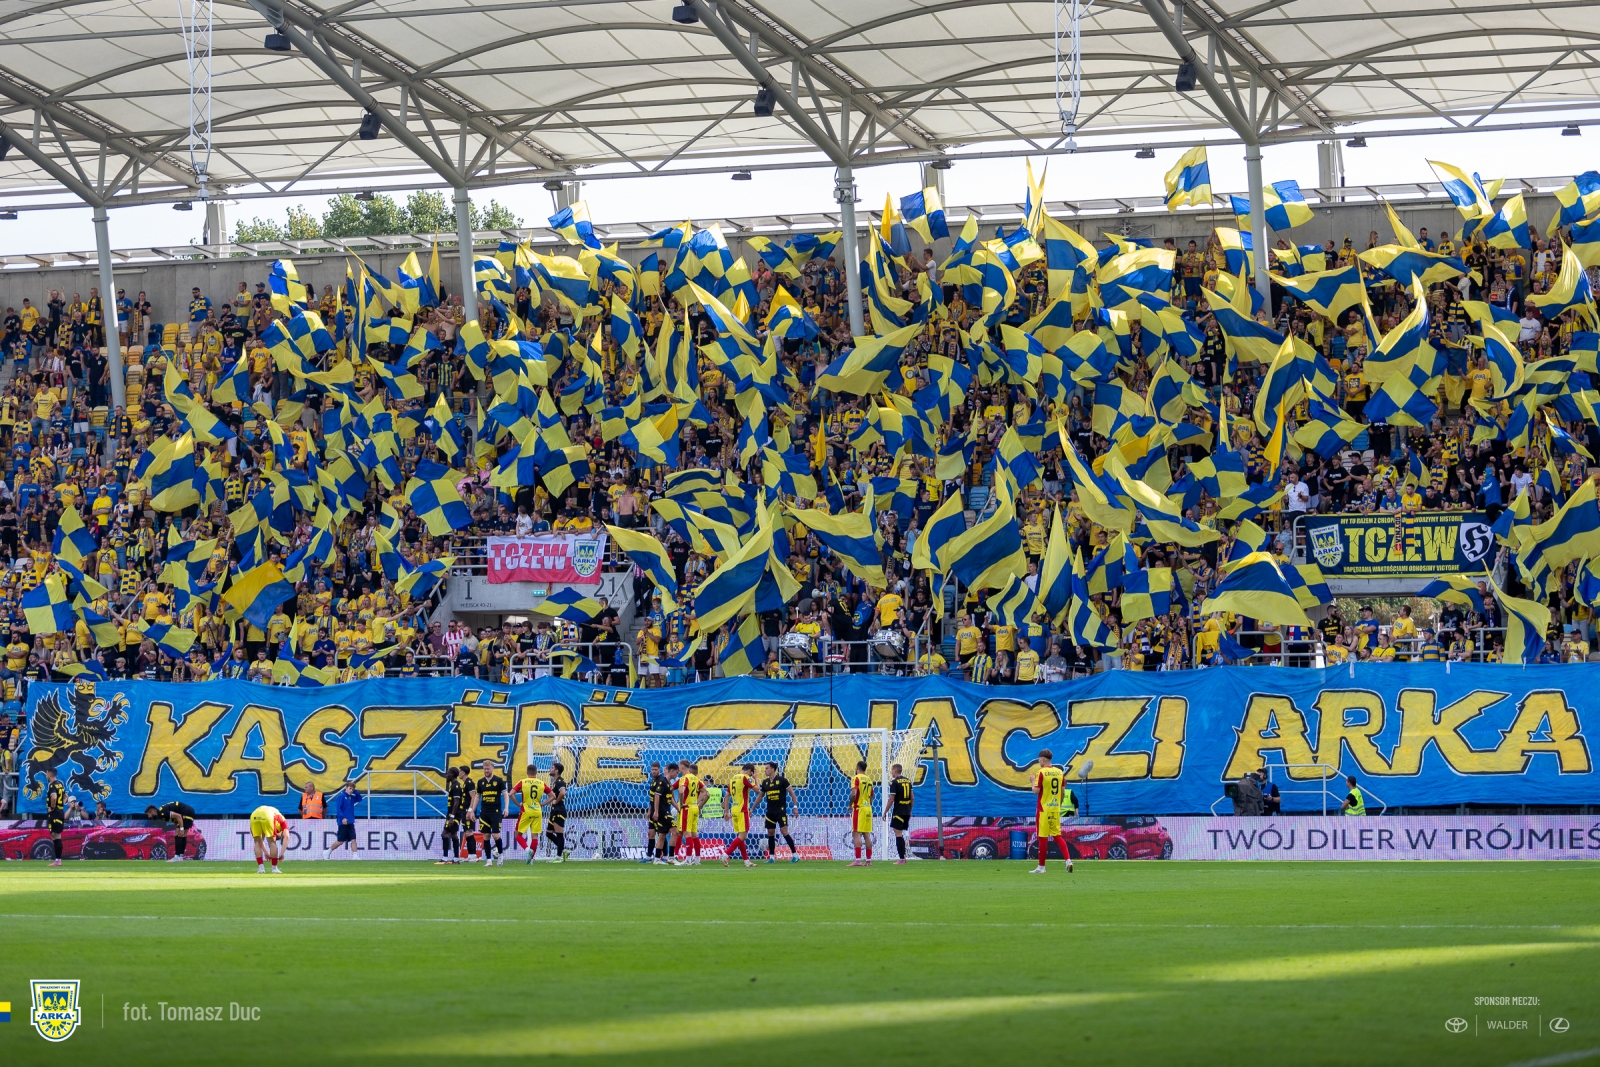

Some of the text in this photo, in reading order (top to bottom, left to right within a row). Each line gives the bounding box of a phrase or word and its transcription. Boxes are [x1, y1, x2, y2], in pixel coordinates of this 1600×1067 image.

[1318, 546, 1340, 556] ARKA
[1344, 525, 1458, 563] TCZEW
[490, 543, 569, 571] TCZEW
[594, 576, 618, 597] 21
[683, 695, 1189, 792] ZNACZI
[1221, 688, 1593, 782] ARKA
[530, 785, 538, 800] 6
[731, 781, 737, 797] 5
[901, 783, 910, 799] 11
[1051, 777, 1059, 795] 9
[236, 826, 313, 850] TÓJ
[408, 831, 435, 850] W
[1207, 823, 1295, 850] TWÓJ
[1308, 829, 1394, 850] DILER
[1406, 829, 1438, 850] W
